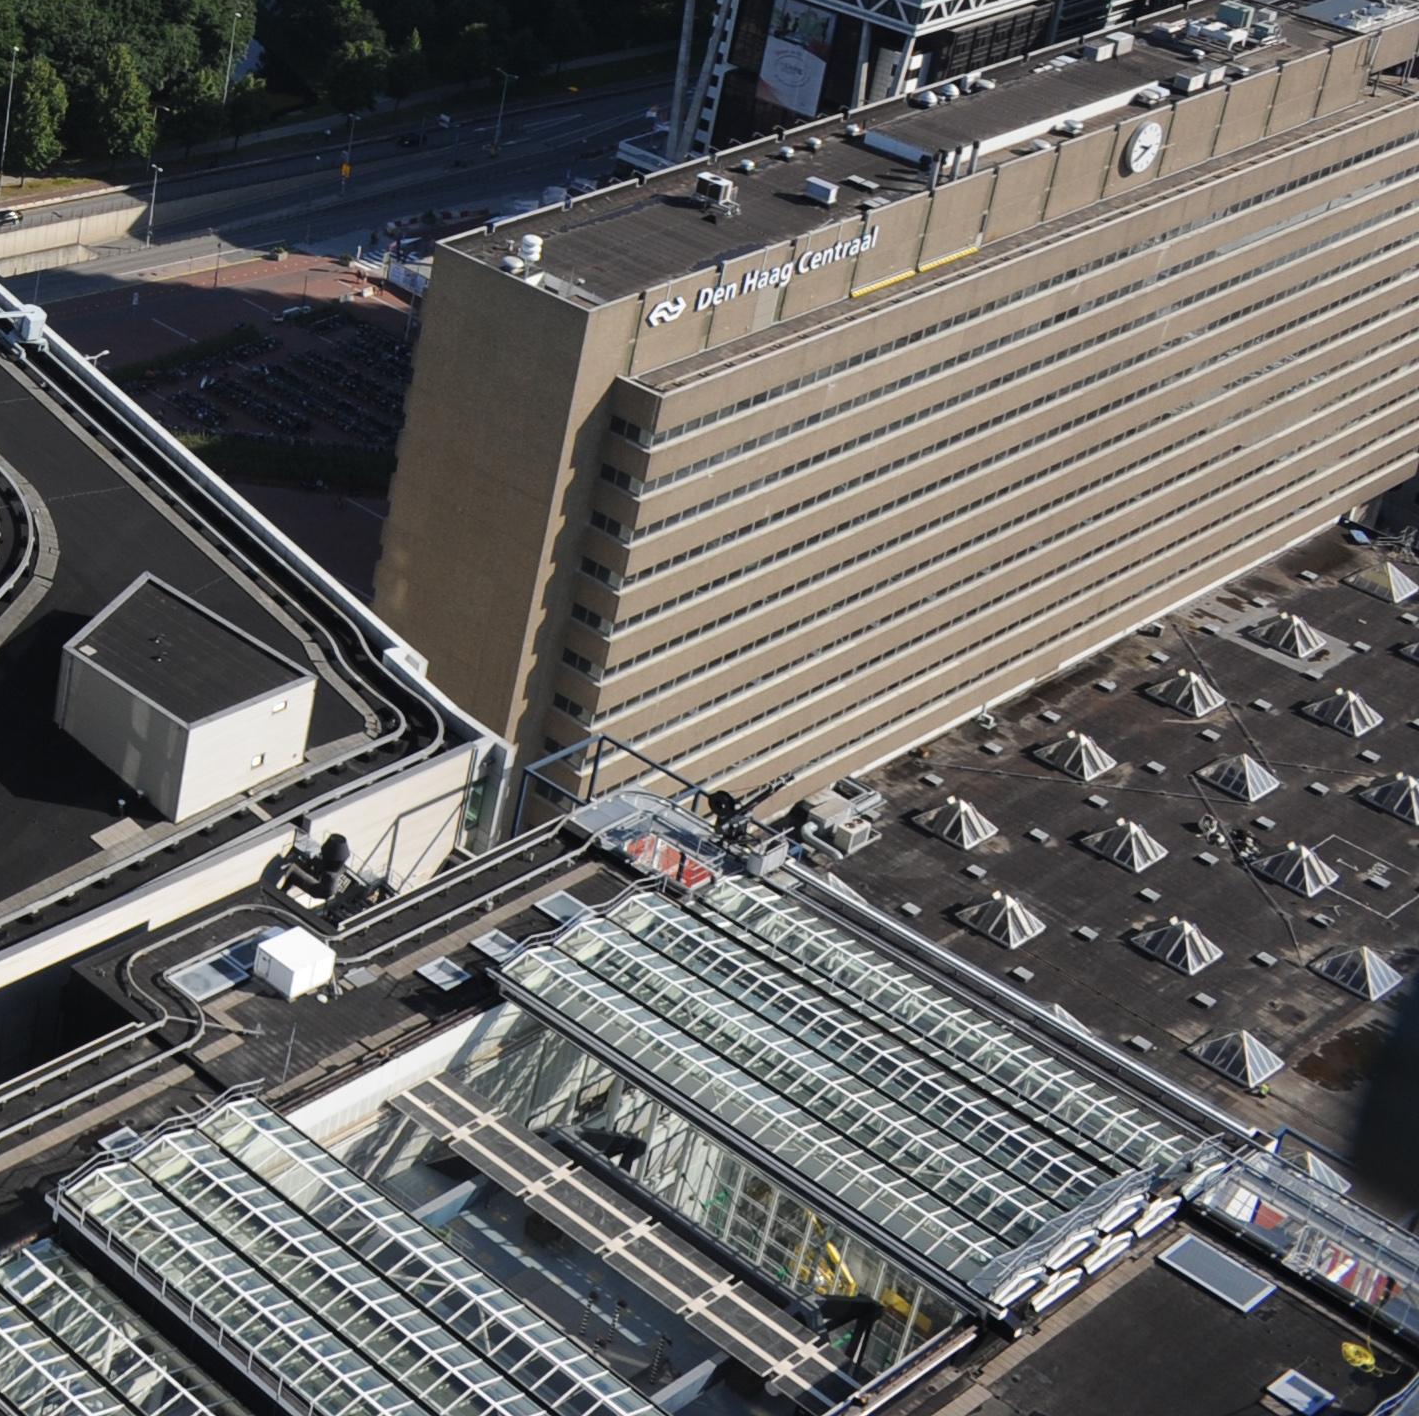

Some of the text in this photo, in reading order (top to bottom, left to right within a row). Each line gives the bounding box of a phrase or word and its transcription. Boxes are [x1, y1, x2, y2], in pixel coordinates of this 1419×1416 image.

[697, 226, 879, 311] Den Haag Centraal
